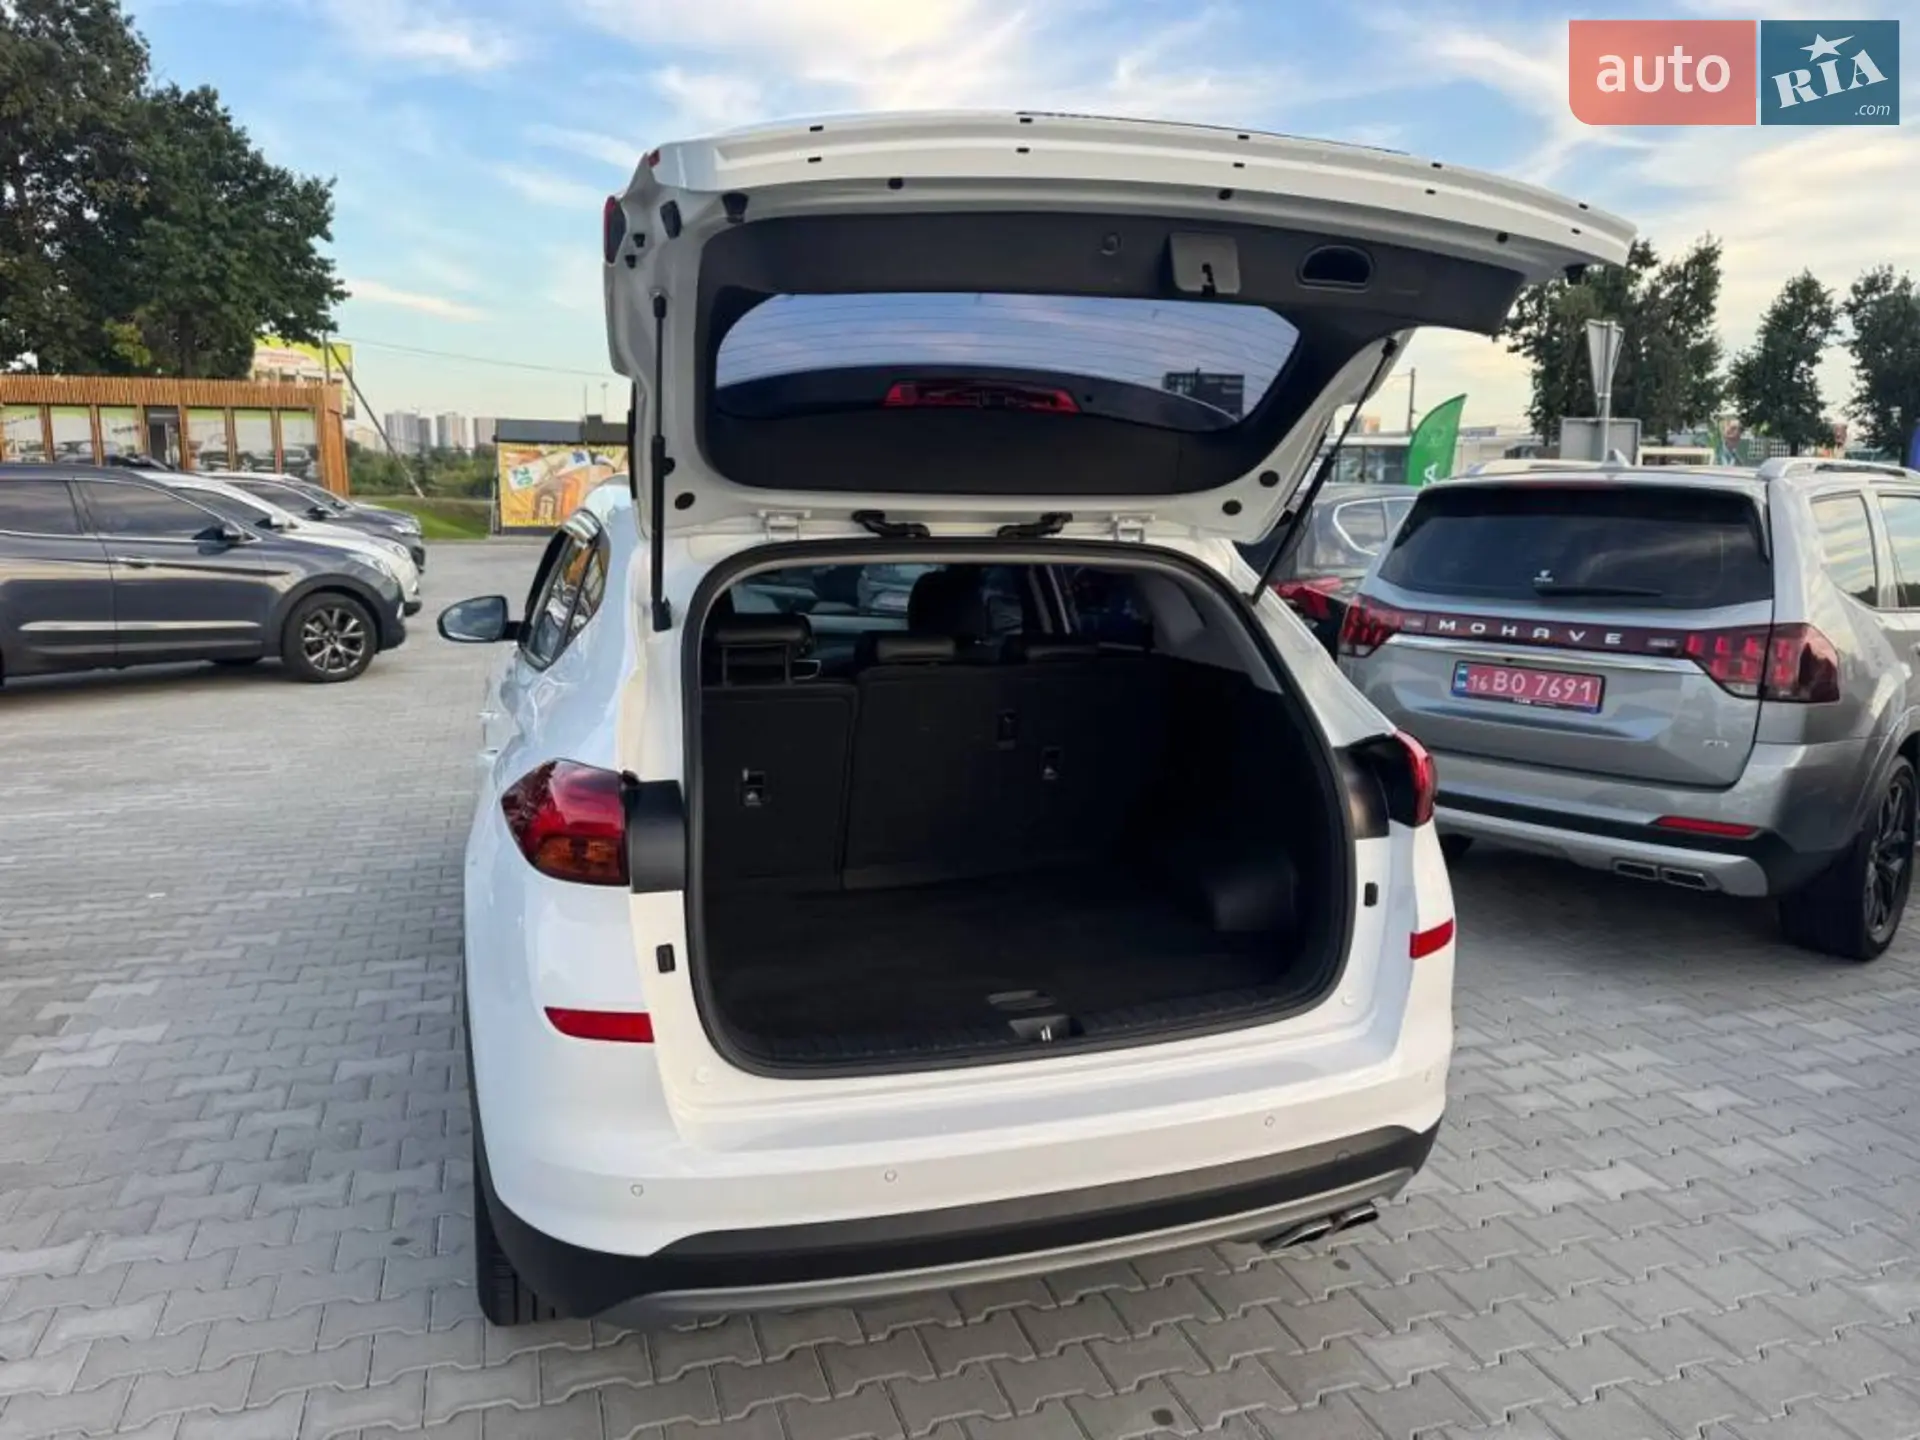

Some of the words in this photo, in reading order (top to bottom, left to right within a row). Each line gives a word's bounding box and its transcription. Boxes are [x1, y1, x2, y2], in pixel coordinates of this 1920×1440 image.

[1438, 619, 1623, 645] MOHAVE
[1469, 674, 1488, 691] 16
[1534, 675, 1592, 702] 7691
